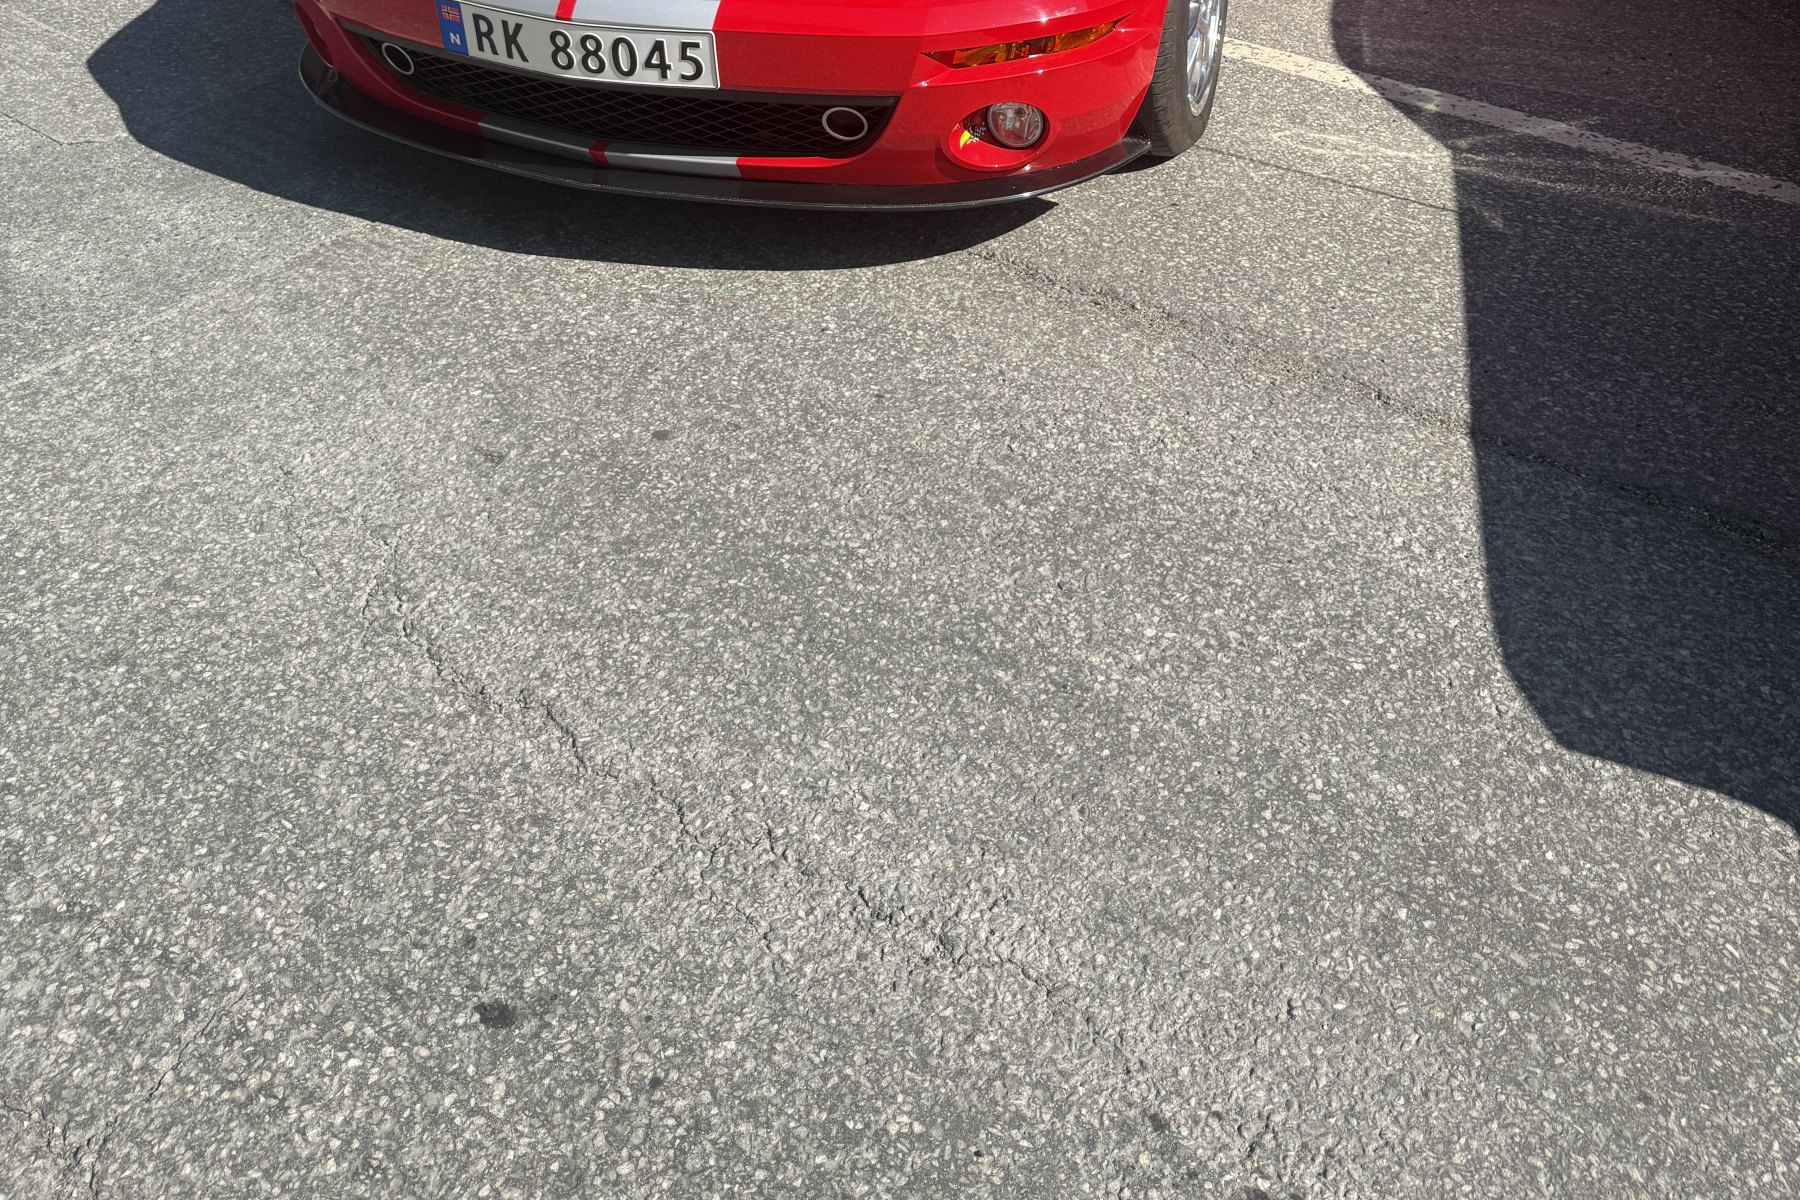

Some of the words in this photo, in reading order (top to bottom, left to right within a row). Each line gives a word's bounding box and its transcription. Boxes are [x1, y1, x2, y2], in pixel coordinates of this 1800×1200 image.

[450, 32, 461, 46] N
[472, 12, 530, 63] RK
[550, 29, 705, 82] 88045
